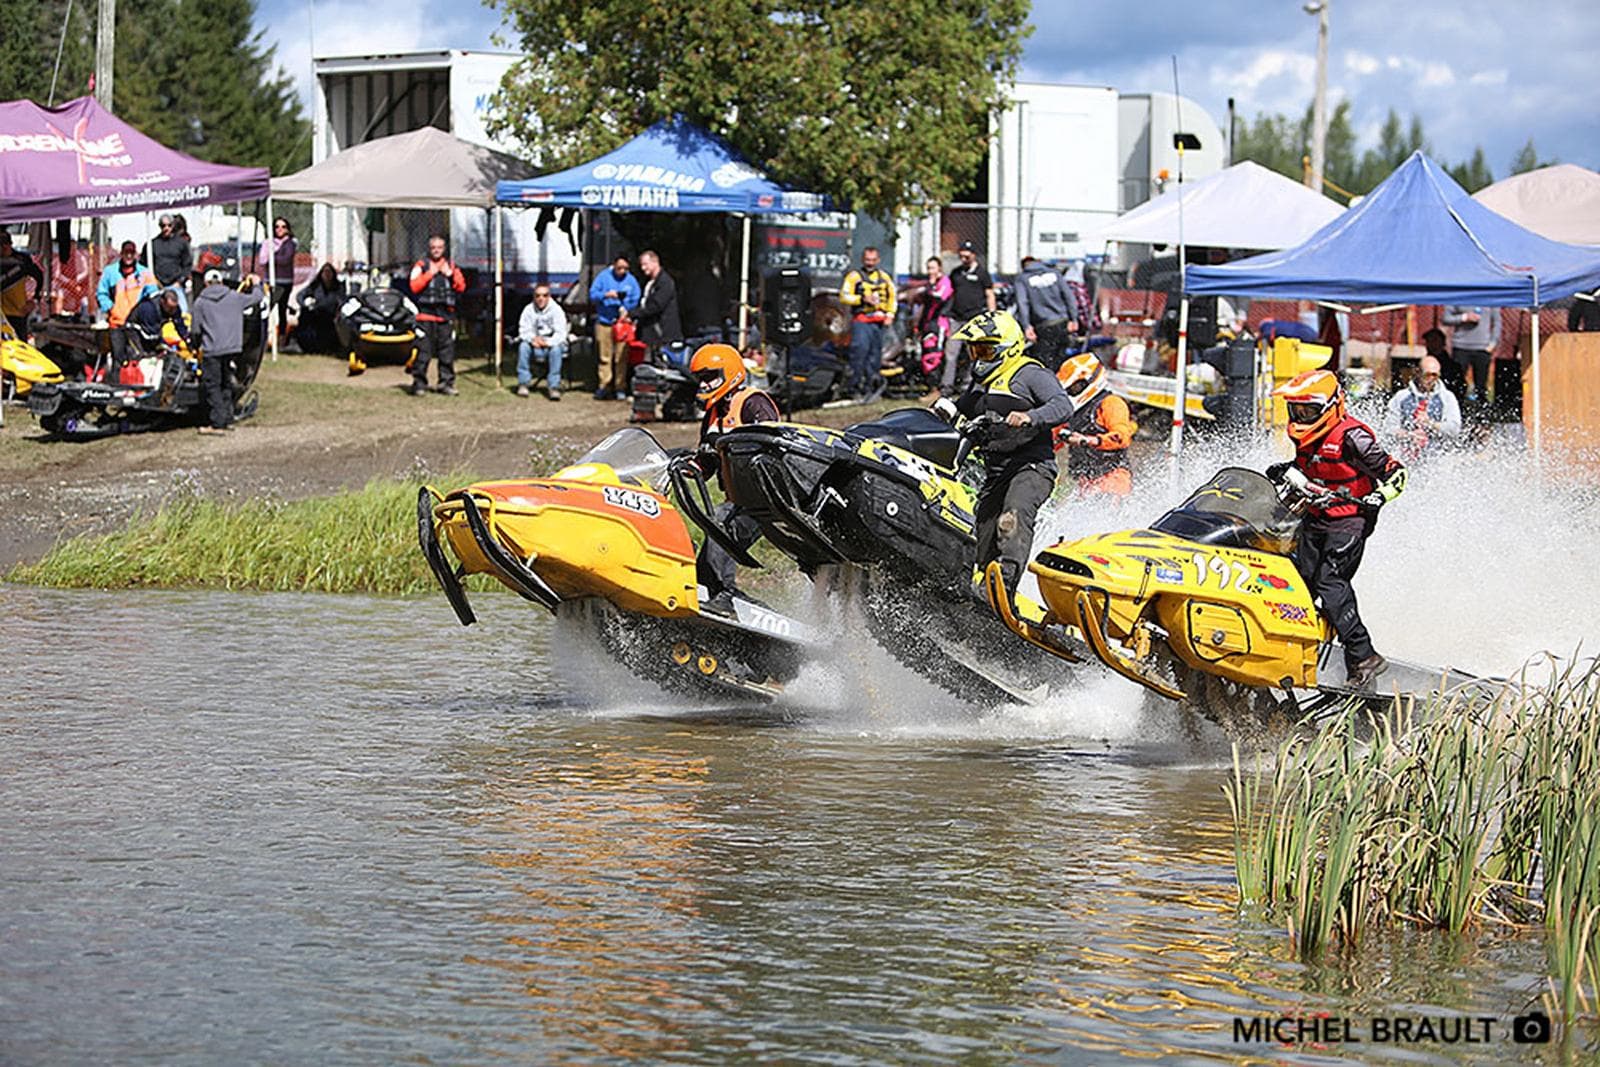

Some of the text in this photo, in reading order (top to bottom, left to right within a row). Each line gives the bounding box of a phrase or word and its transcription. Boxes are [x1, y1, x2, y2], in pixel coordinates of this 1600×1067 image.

[615, 164, 706, 192] YAMAHA
[601, 186, 680, 208] YAMAHA
[1192, 552, 1251, 594] 192
[749, 607, 790, 636] 700
